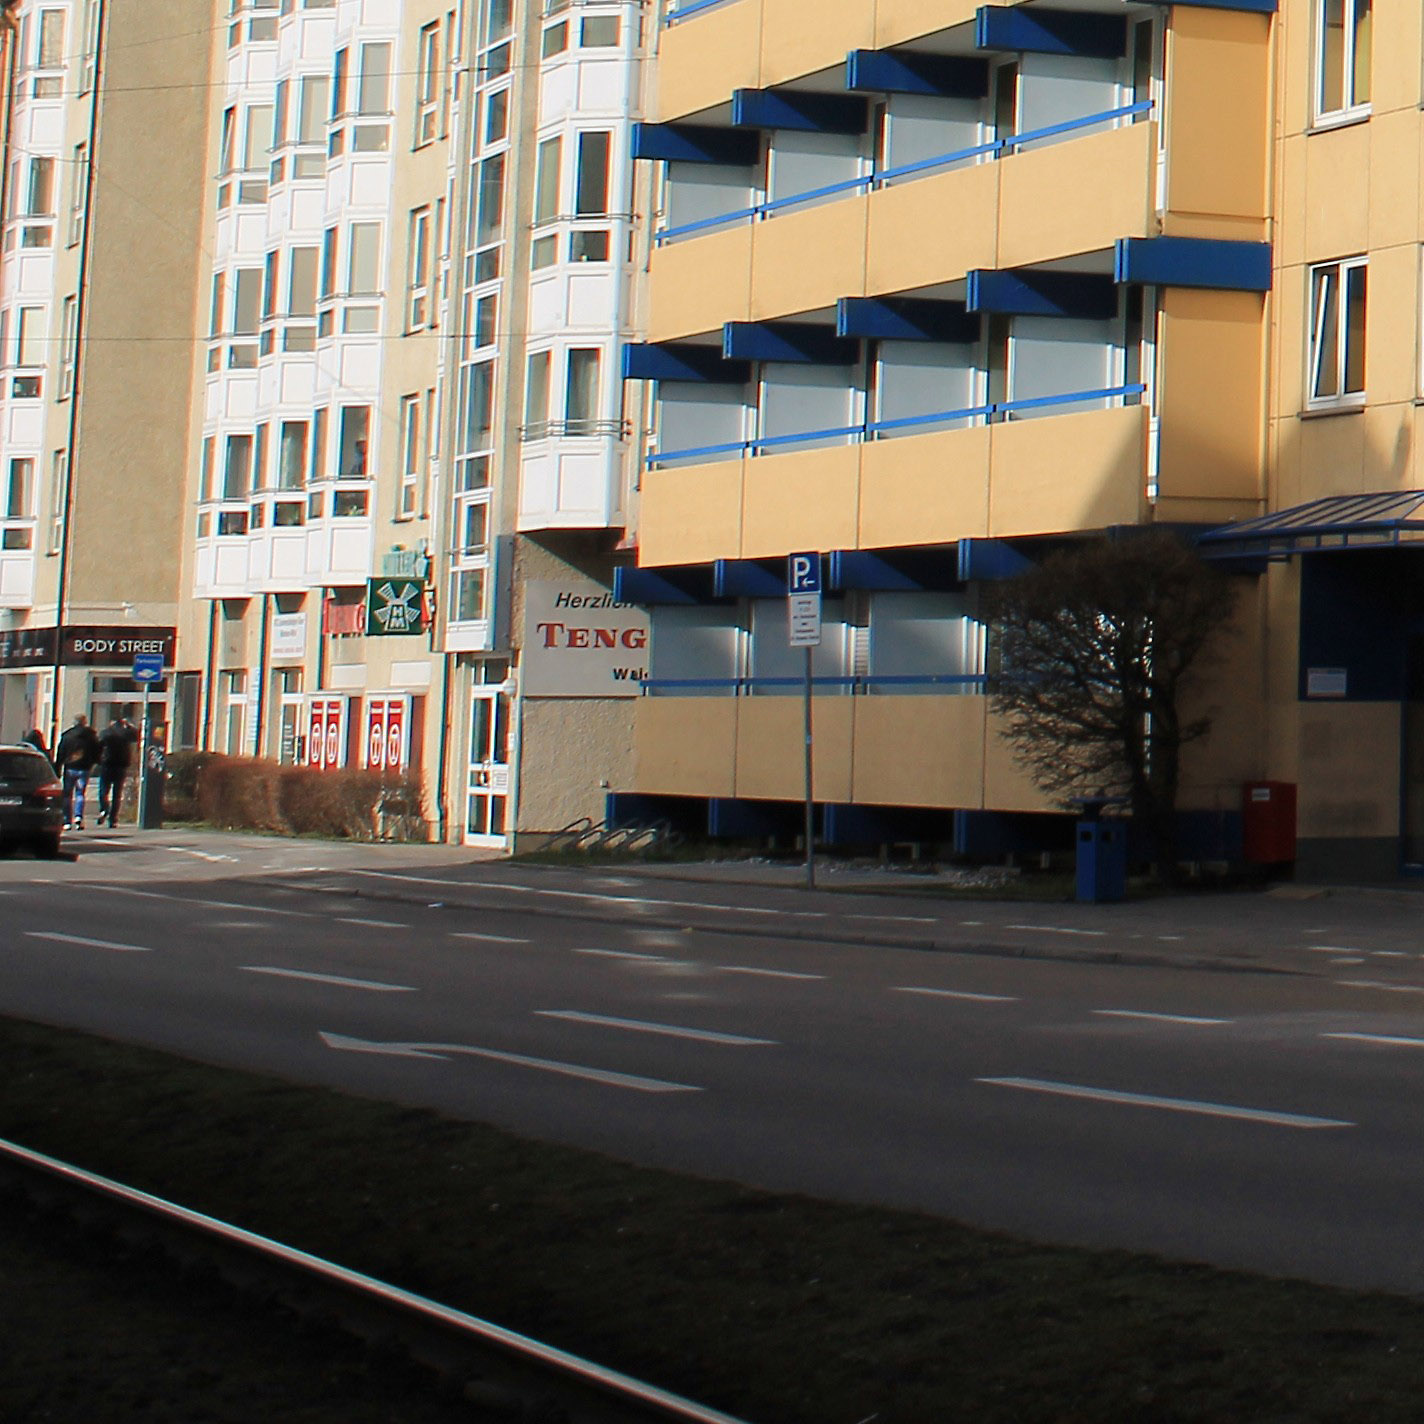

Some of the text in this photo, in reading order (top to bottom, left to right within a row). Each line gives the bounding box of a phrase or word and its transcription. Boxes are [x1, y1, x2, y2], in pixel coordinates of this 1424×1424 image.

[793, 557, 811, 589] P
[73, 639, 165, 653] BODY STREET
[537, 623, 647, 648] TENG
